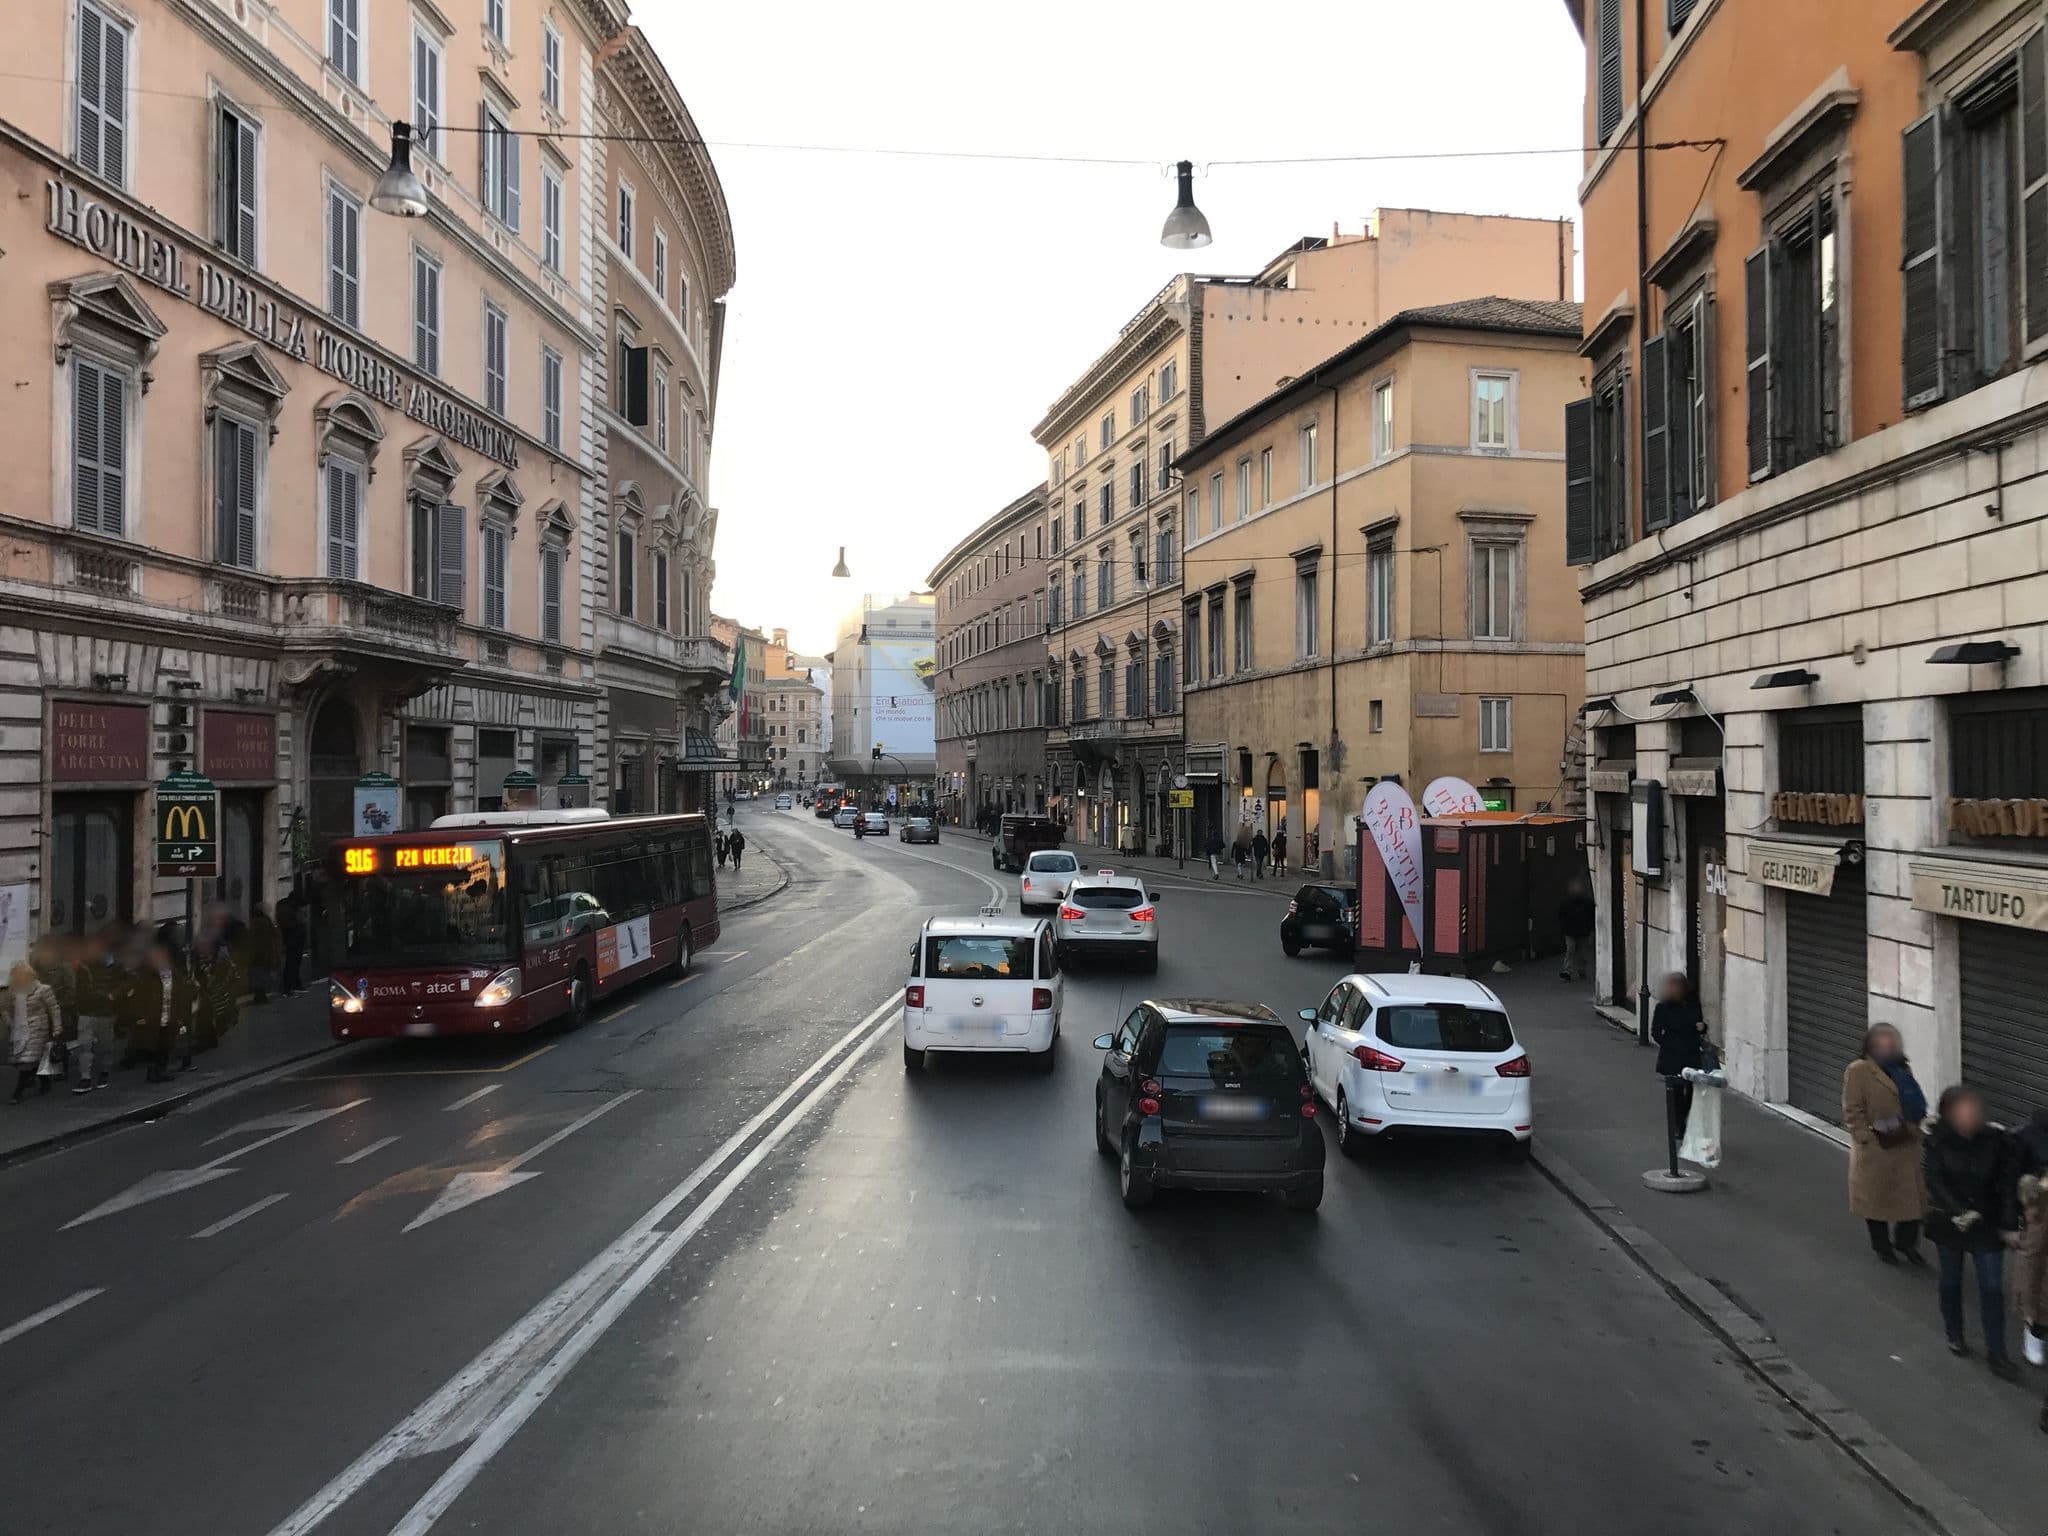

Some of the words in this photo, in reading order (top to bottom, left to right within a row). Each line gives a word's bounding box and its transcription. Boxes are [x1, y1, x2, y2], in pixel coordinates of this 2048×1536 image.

[46, 179, 191, 298] HOTEL
[199, 263, 309, 362] DELLA
[315, 327, 404, 411] TORRE
[404, 382, 520, 471] ARGENTINA
[59, 712, 106, 729] DELLA
[59, 733, 106, 749] TORRE
[60, 755, 139, 769] ARGENTINA
[1771, 791, 1864, 826] GELATERIA
[345, 848, 373, 873] 916
[396, 849, 419, 867] PZA
[423, 847, 473, 865] VENEZIA
[1761, 861, 1819, 888] GELATERIA
[1942, 884, 2026, 920] TARTUFO
[471, 970, 489, 978] 3025
[373, 986, 407, 997] ROMA
[426, 982, 456, 994] atac
